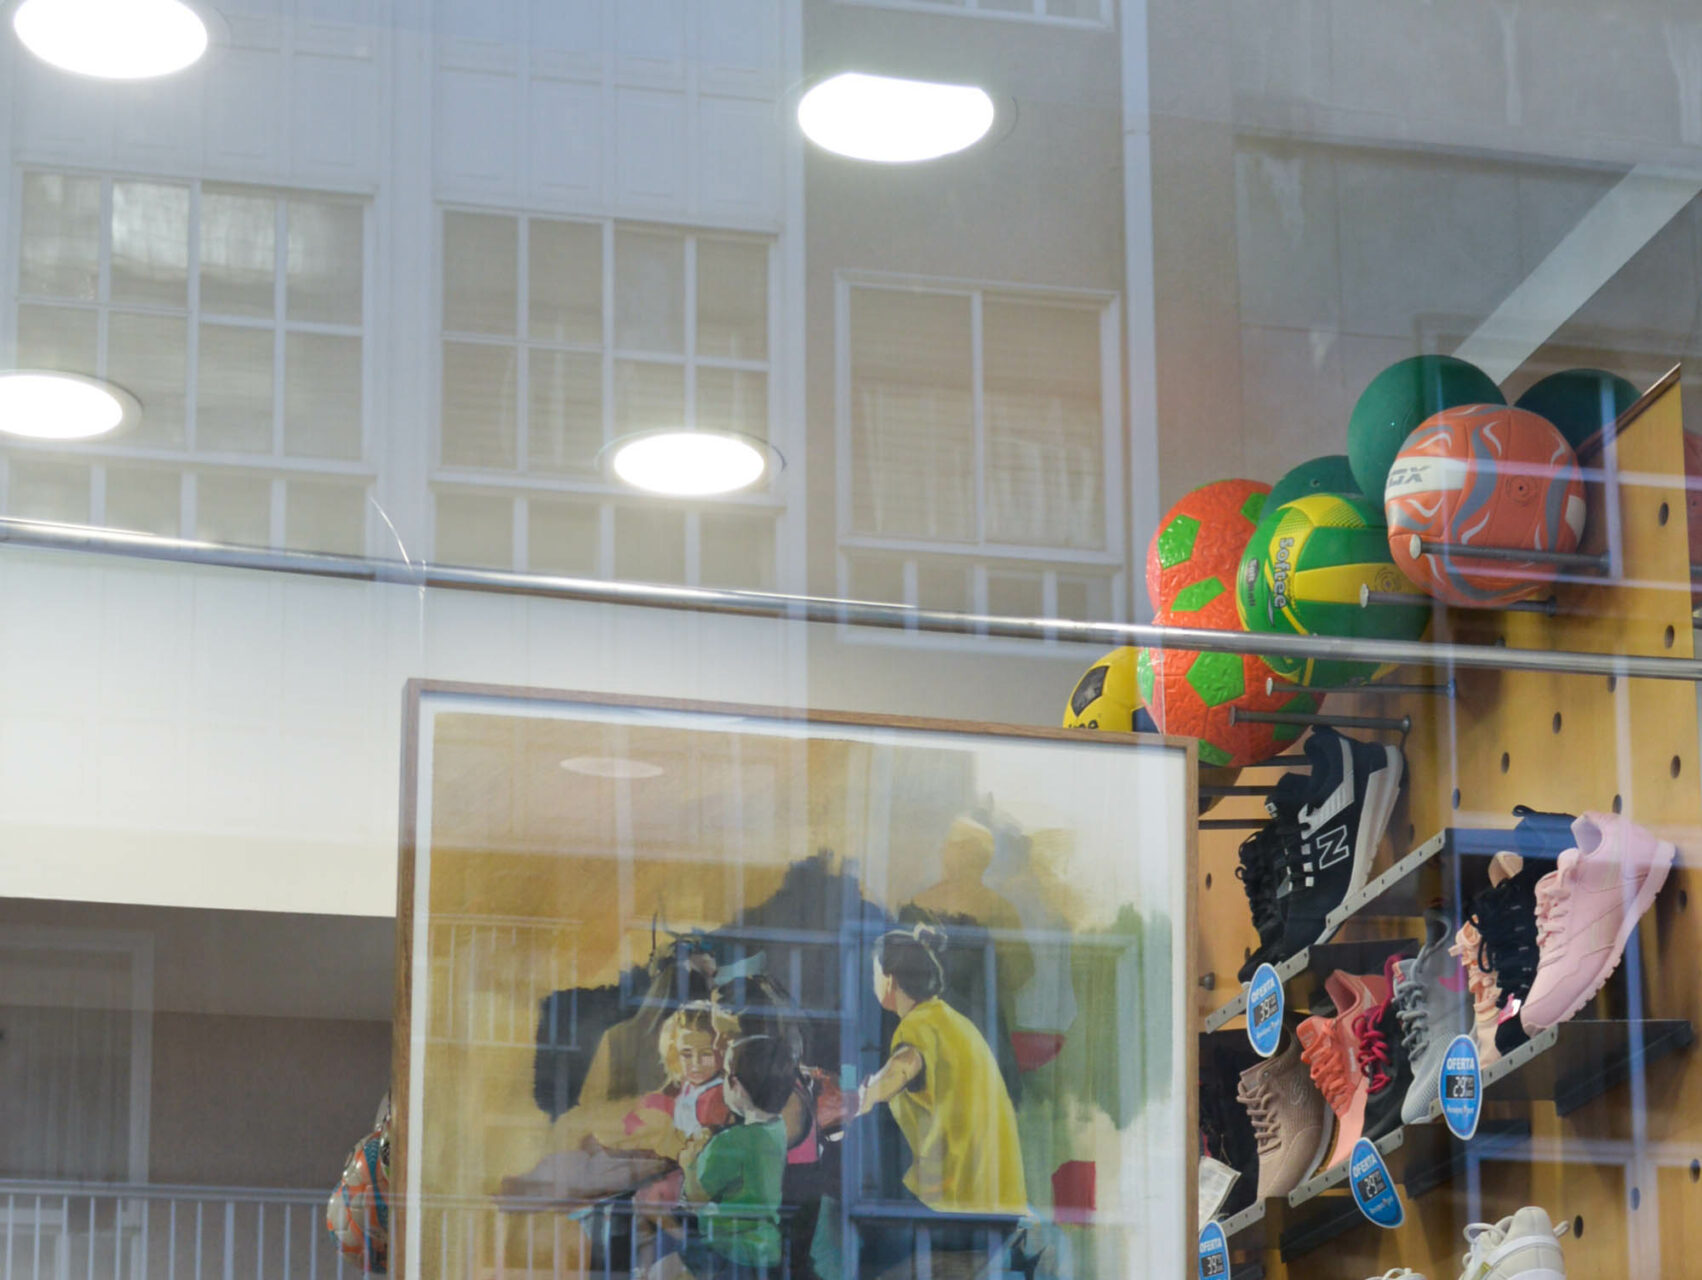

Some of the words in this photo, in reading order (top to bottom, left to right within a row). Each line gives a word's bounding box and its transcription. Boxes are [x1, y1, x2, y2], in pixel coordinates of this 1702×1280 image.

[1273, 537, 1295, 609] Softee
[1251, 977, 1276, 1003] OFERTA
[1446, 1056, 1475, 1070] OFERTA
[1352, 1153, 1378, 1178] OFERTA
